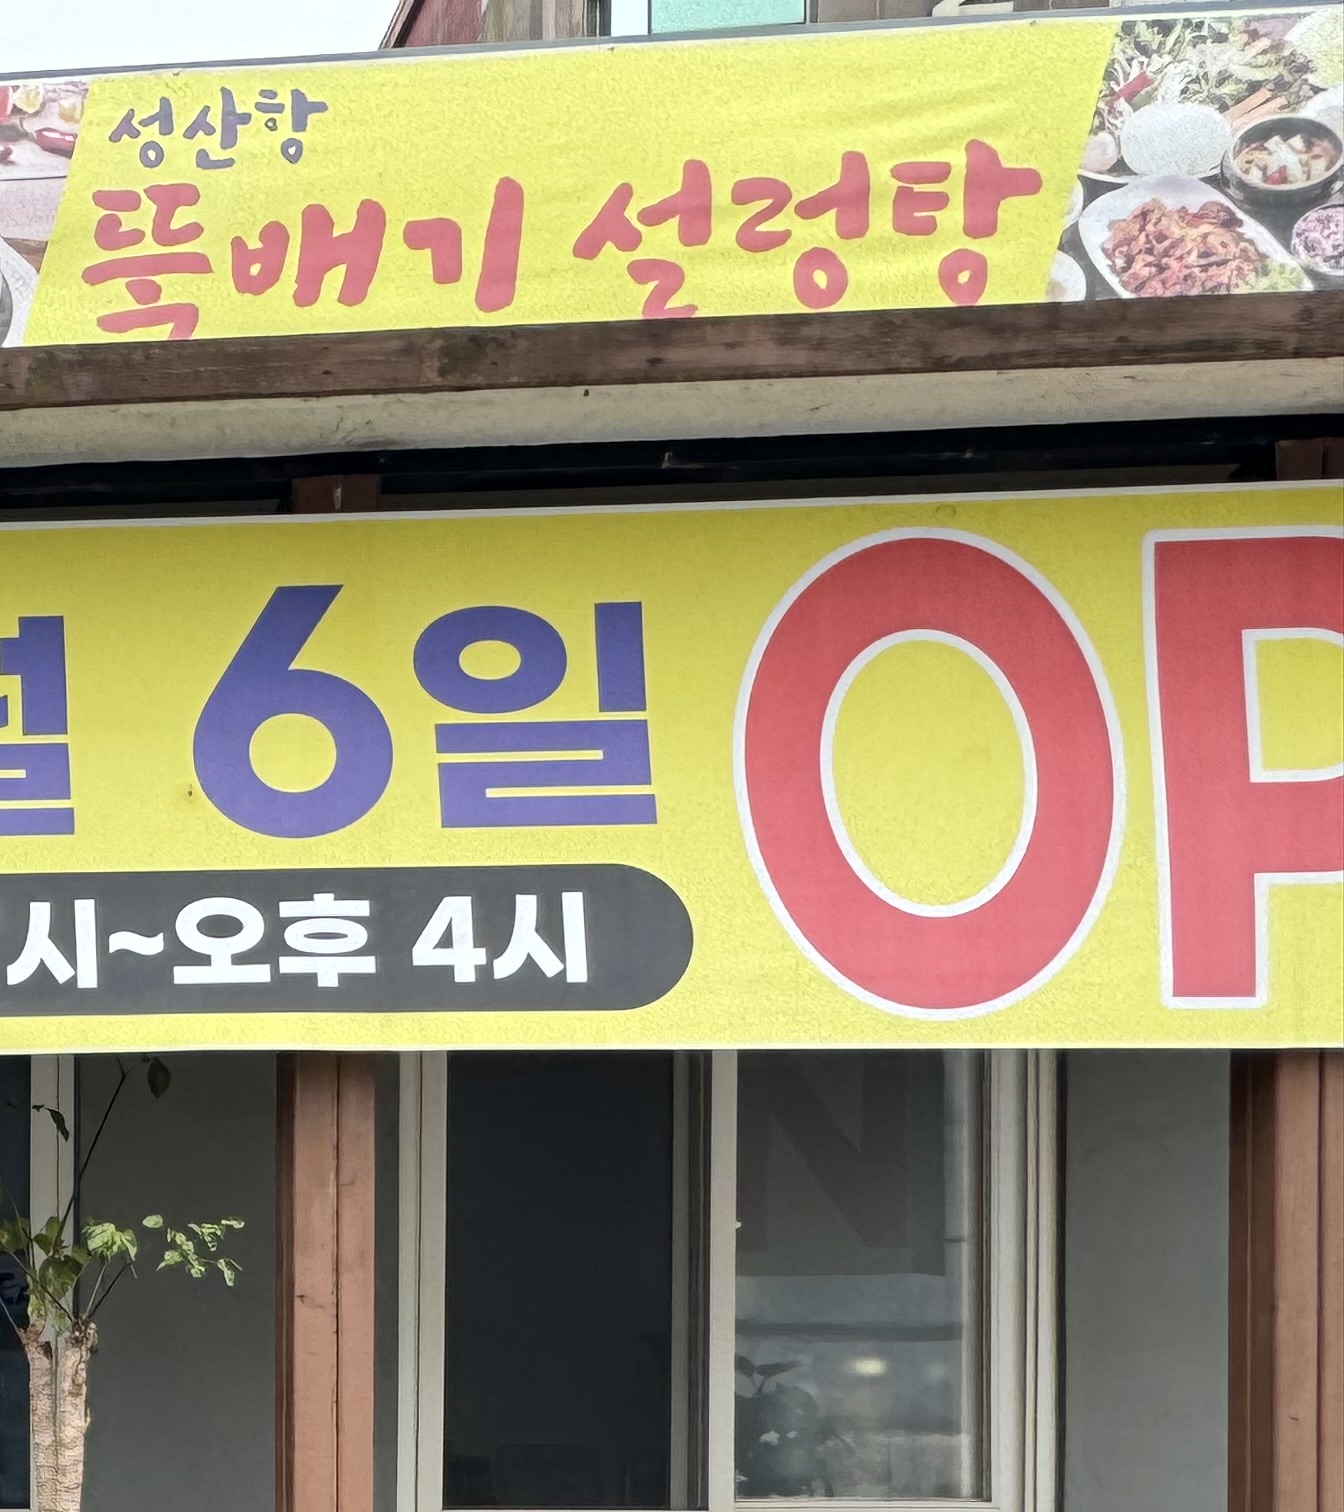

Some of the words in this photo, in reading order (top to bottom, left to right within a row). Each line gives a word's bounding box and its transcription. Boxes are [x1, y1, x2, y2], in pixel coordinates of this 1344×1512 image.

[108, 86, 329, 170] 성산항
[82, 176, 524, 340] 뚝배기
[573, 140, 1042, 318] 설렁탕
[193, 585, 656, 837] 6일
[412, 891, 588, 984] 4시
